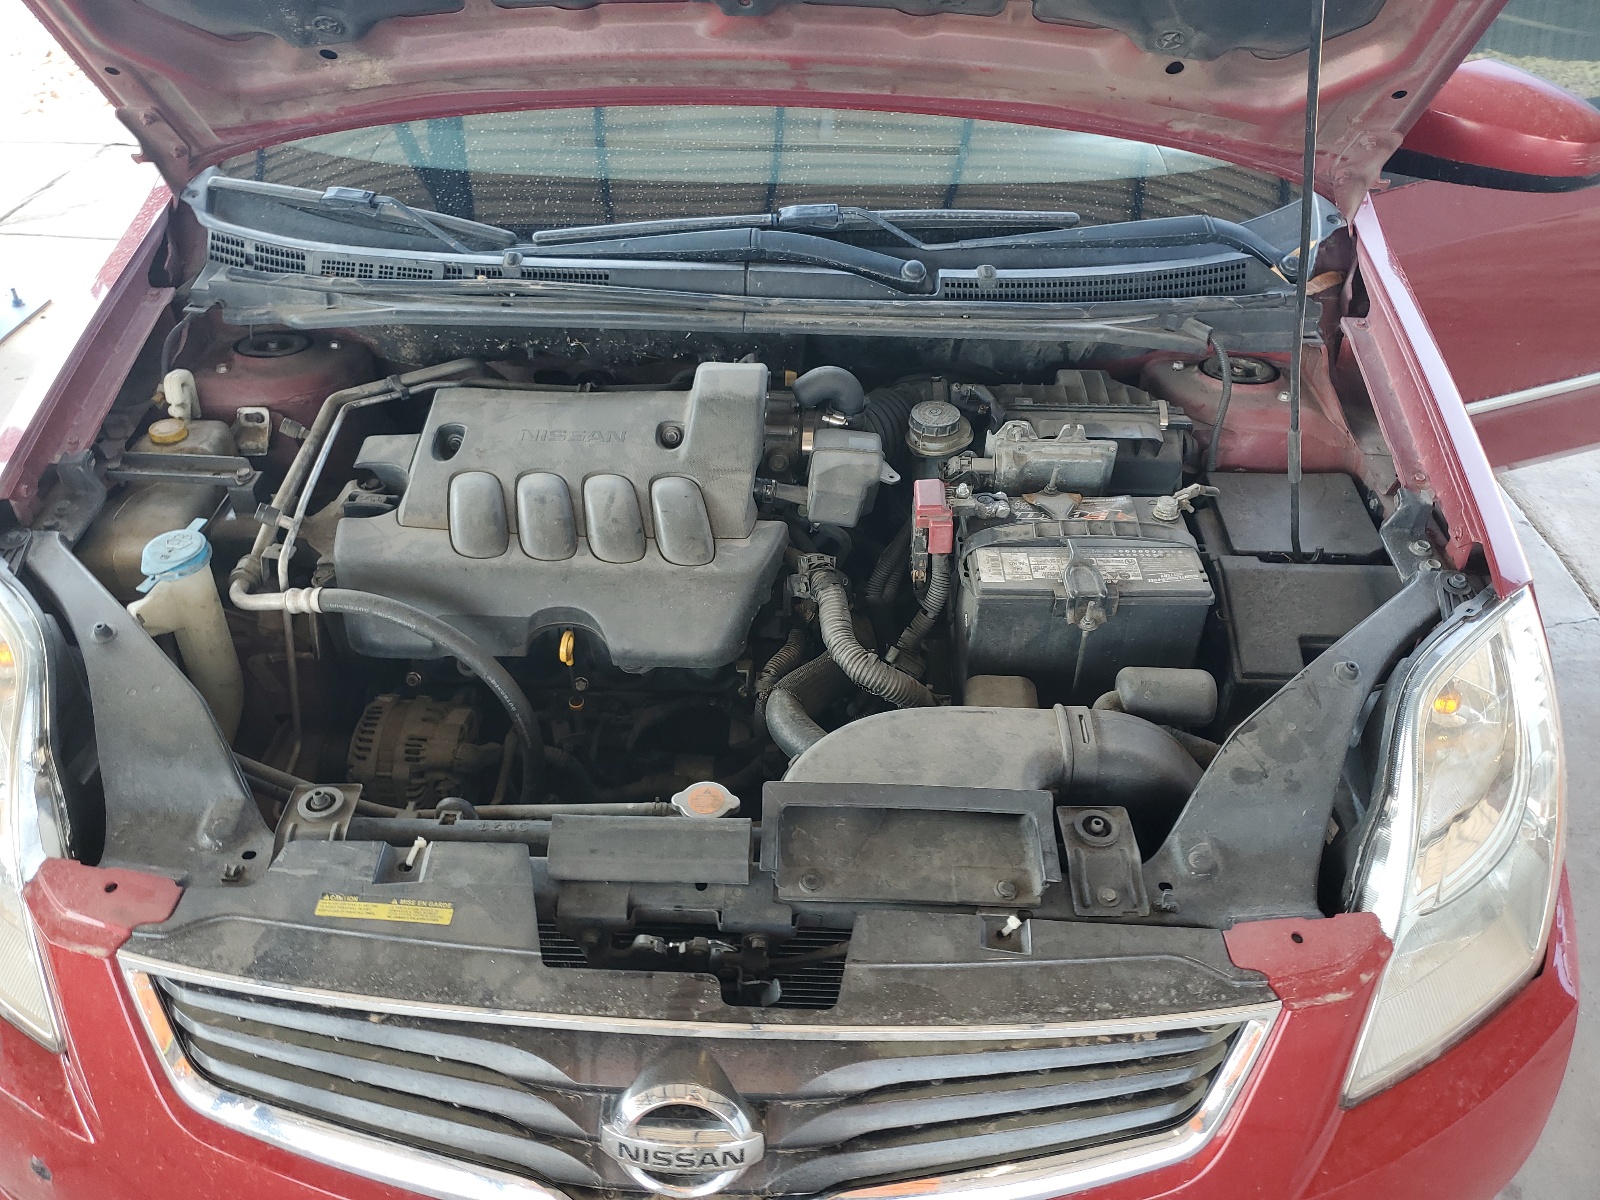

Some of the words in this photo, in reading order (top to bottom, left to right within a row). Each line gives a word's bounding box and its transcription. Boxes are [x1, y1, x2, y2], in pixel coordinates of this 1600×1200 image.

[521, 428, 627, 443] NISSAN
[399, 898, 416, 906] MISE
[417, 899, 428, 907] EN
[428, 901, 453, 909] GARDE
[618, 1141, 745, 1168] NISSAN
